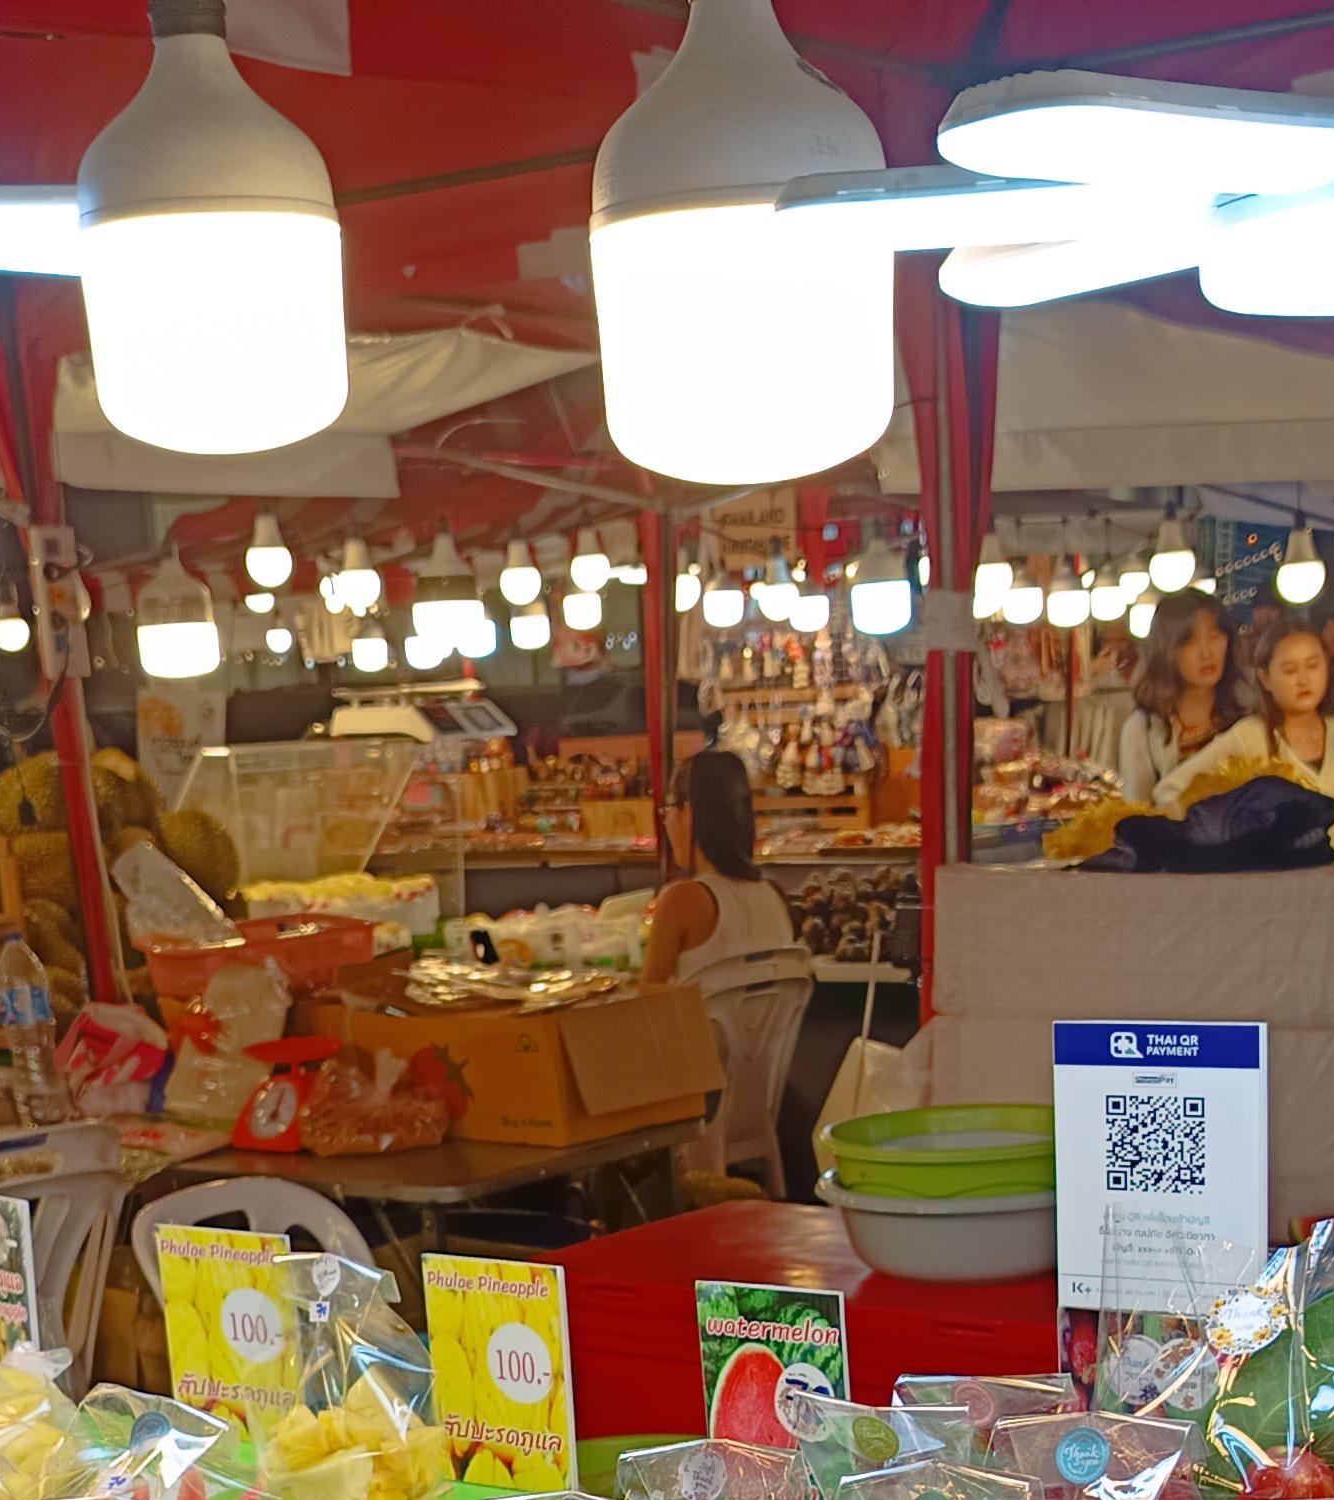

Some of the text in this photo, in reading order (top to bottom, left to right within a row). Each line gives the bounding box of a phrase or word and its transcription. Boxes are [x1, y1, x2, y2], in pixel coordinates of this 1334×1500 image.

[1145, 1046, 1200, 1057] PAYMENT
[1146, 1034, 1199, 1046] THAI QR
[160, 1240, 205, 1258] Phulae
[426, 1270, 549, 1299] Phulae Pineapple
[229, 1312, 283, 1346] 100.-
[707, 1316, 839, 1345] watermelon
[496, 1349, 551, 1385] 100.-
